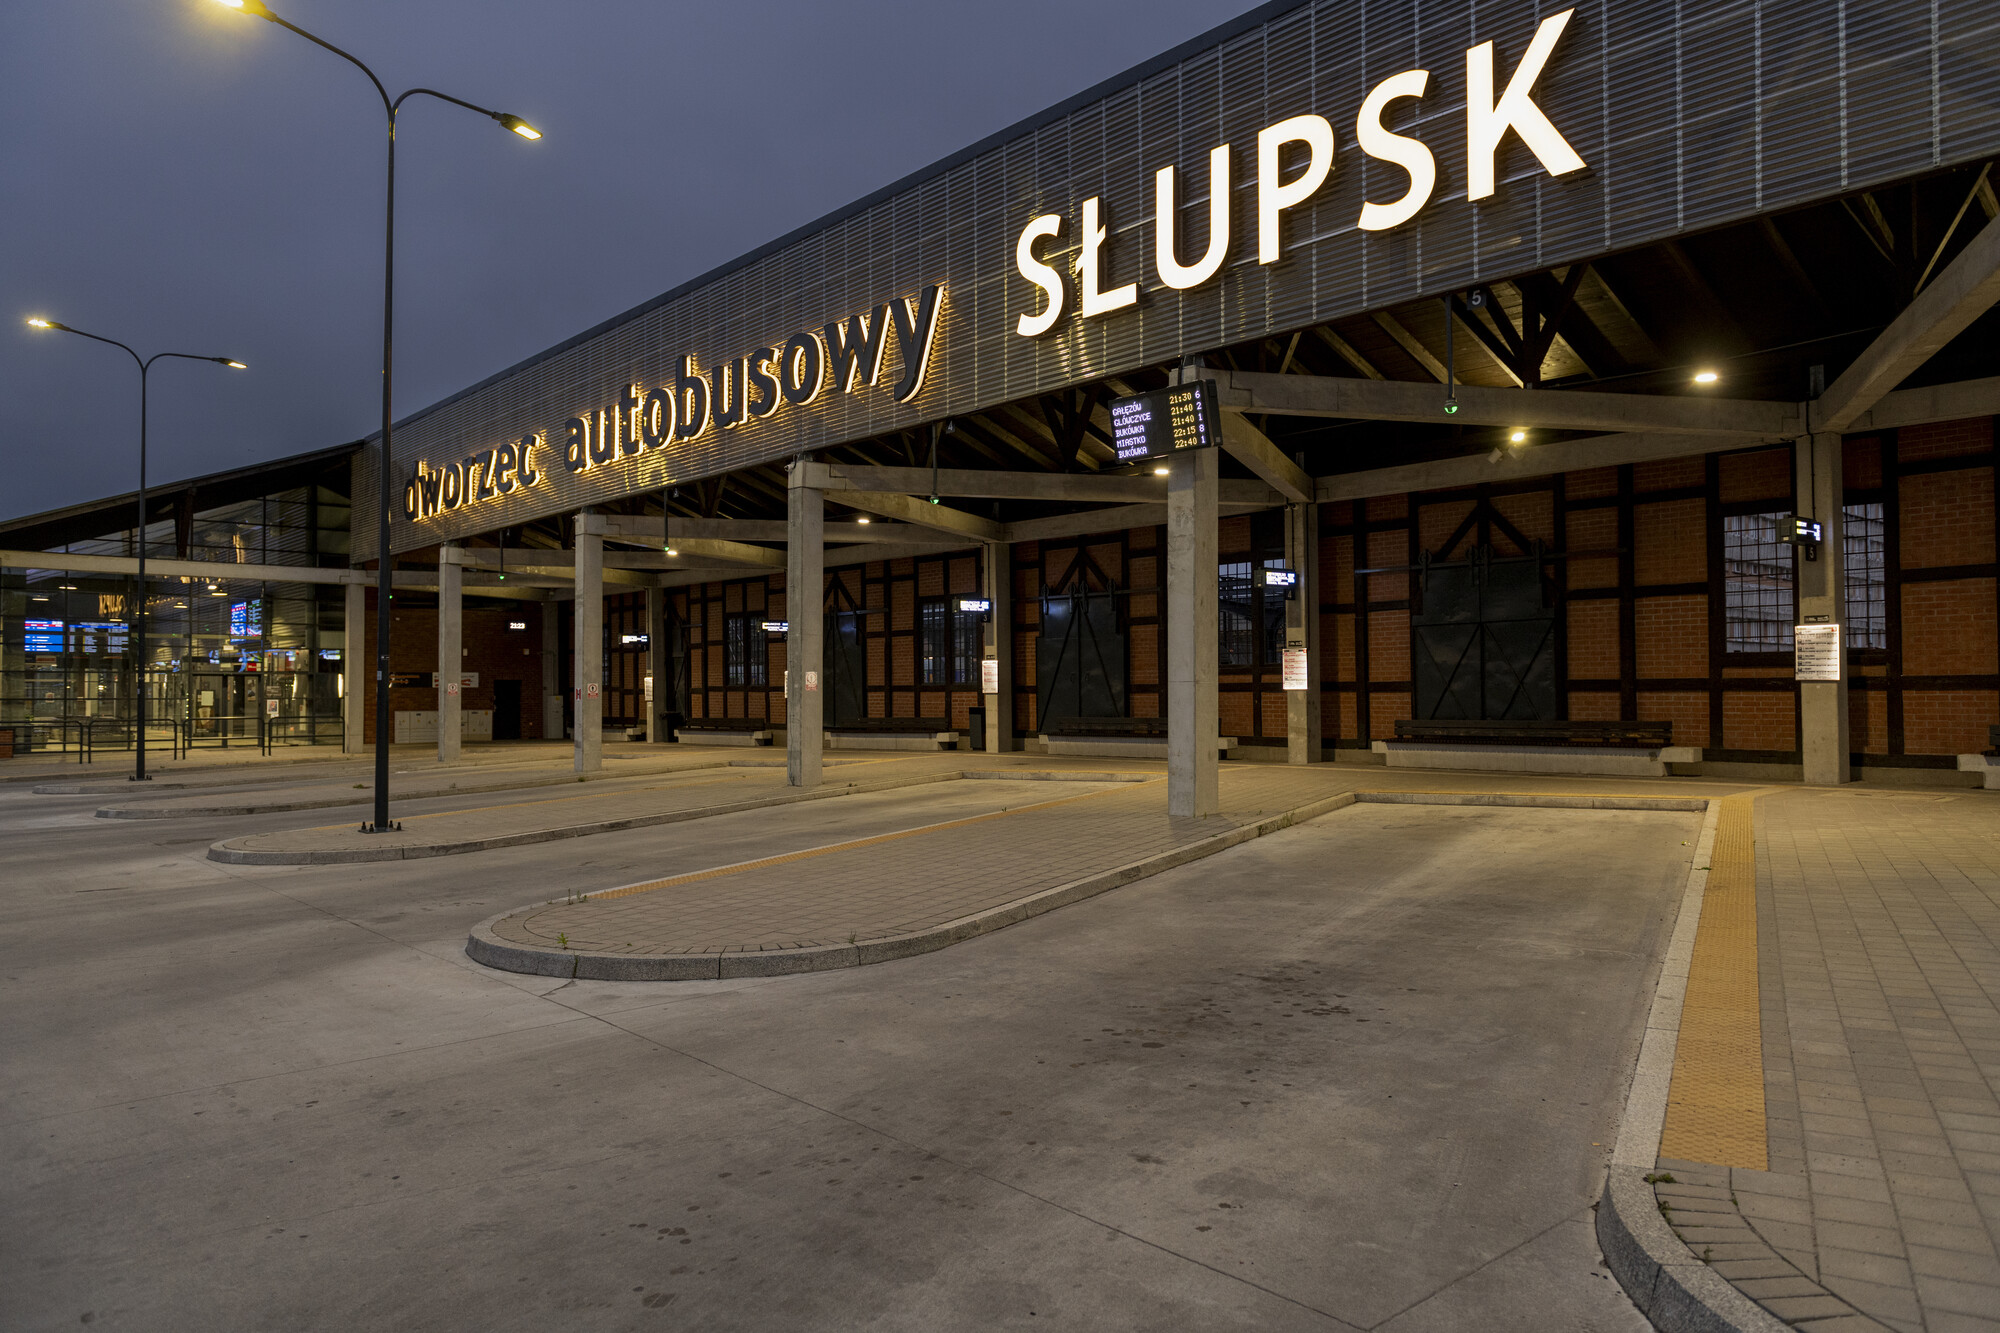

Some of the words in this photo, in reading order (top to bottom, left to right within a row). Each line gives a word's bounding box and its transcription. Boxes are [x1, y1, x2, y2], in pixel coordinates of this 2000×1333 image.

[1016, 8, 1587, 337] SŁUPSK
[1471, 289, 1482, 306] 5
[403, 434, 544, 522] dworzec
[564, 283, 946, 473] autobusowy
[1169, 393, 1192, 404] 21:30
[1194, 390, 1201, 399] 6
[1170, 404, 1193, 415] 21:40
[1196, 402, 1202, 410] 2
[1115, 425, 1145, 438] BUKÓWKA
[1172, 415, 1195, 426] 21:40
[1198, 413, 1203, 421] 1
[1116, 435, 1146, 448] MIASTKO
[1173, 426, 1196, 437] 22:15
[1199, 424, 1205, 432] 8
[1118, 446, 1148, 459] BUKÓWKA
[1174, 437, 1197, 448] 22:40
[1201, 435, 1206, 444] 1
[1809, 547, 1815, 559] 5
[1287, 590, 1292, 599] 4
[983, 614, 988, 622] 3
